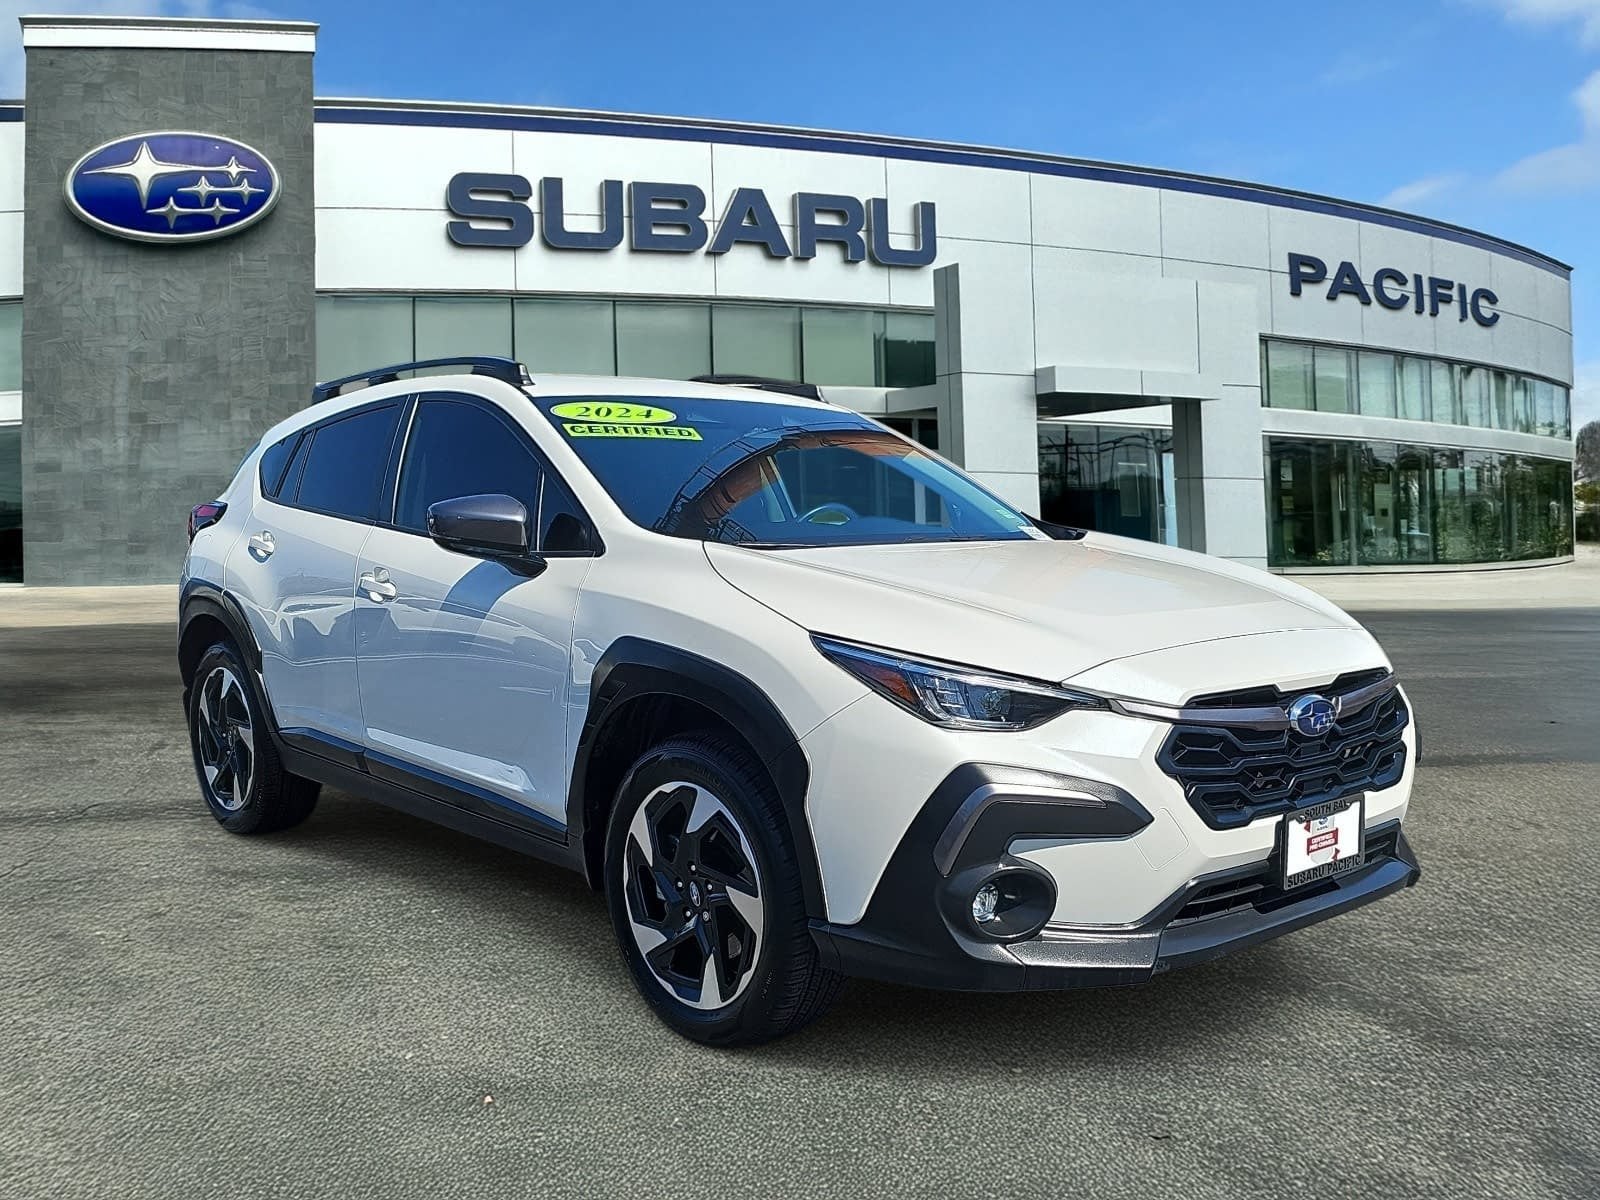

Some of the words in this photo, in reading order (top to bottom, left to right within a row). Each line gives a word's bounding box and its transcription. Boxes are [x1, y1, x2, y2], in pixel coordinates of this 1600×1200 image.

[447, 172, 937, 267] SUBARU
[1288, 252, 1500, 327] PACIFIC
[575, 406, 653, 419] 2024
[569, 425, 692, 437] CERTIFIED
[1304, 802, 1332, 818] SOUTH
[1287, 864, 1327, 888] SUBARU
[1327, 855, 1361, 874] PACIFIC
